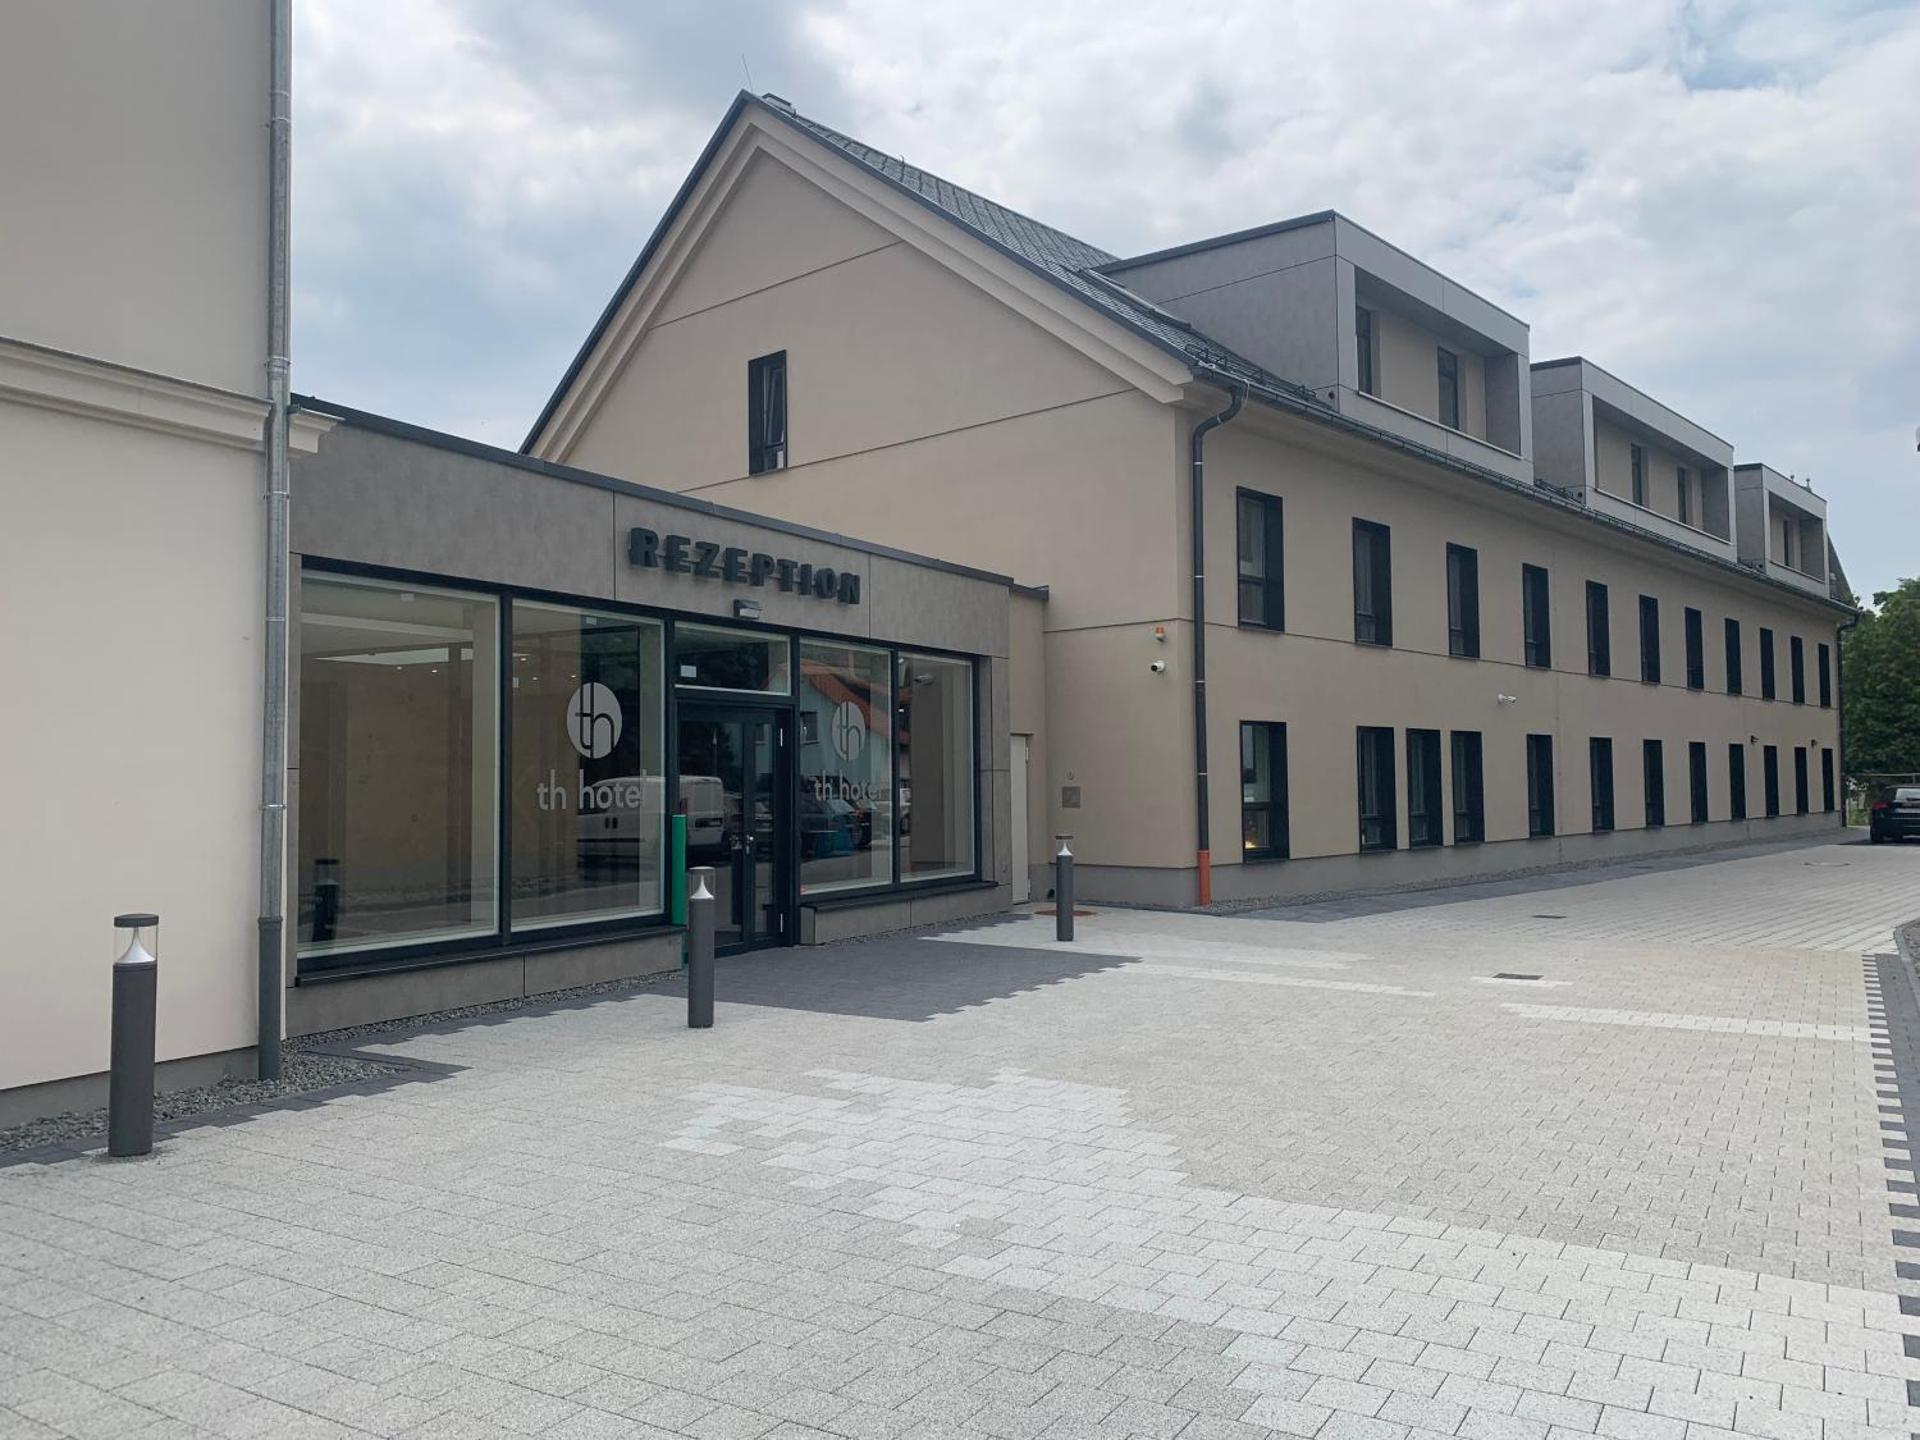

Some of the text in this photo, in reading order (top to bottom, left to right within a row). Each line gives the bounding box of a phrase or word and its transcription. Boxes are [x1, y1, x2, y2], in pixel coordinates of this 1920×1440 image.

[628, 527, 861, 605] REZEPTION
[537, 769, 648, 810] th hotel
[814, 770, 832, 801] th
